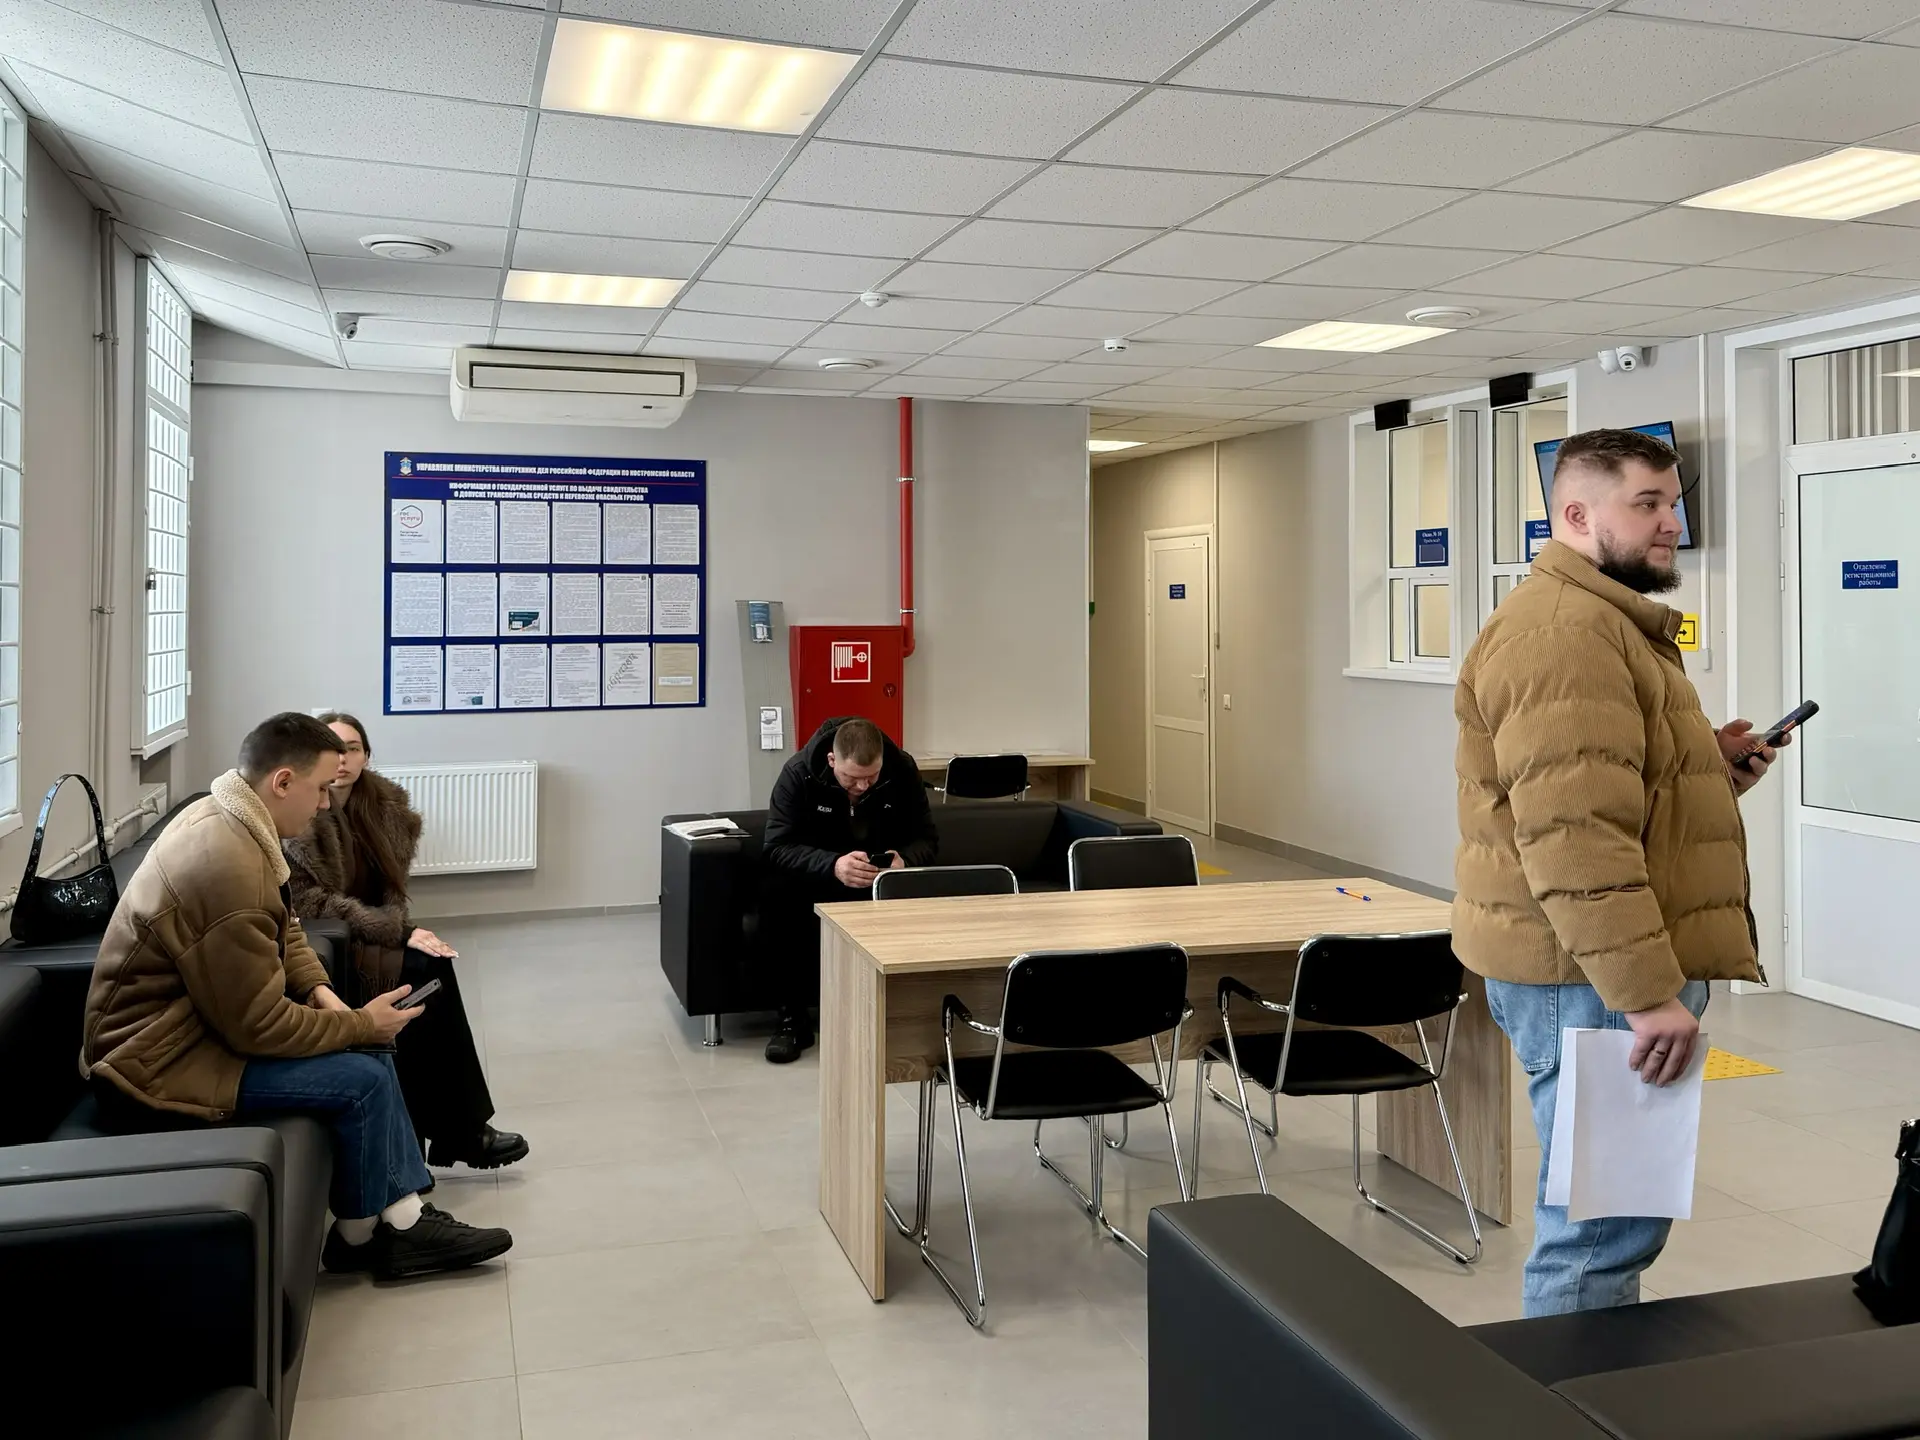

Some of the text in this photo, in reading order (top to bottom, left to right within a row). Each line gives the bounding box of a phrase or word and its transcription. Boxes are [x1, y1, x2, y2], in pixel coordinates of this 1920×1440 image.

[416, 463, 454, 472] УПРАВЛЕНИЕ
[454, 464, 500, 473] МИНИСТЕРСТВА
[500, 466, 536, 474] ВНУТРЕННИХ
[550, 467, 586, 475] РОССИЙСКОЙ
[588, 468, 620, 476] ФЕДЕРАЦИИ
[1853, 562, 1886, 572] Отделение
[1844, 570, 1896, 580] регистрационной
[1858, 579, 1881, 588] работы
